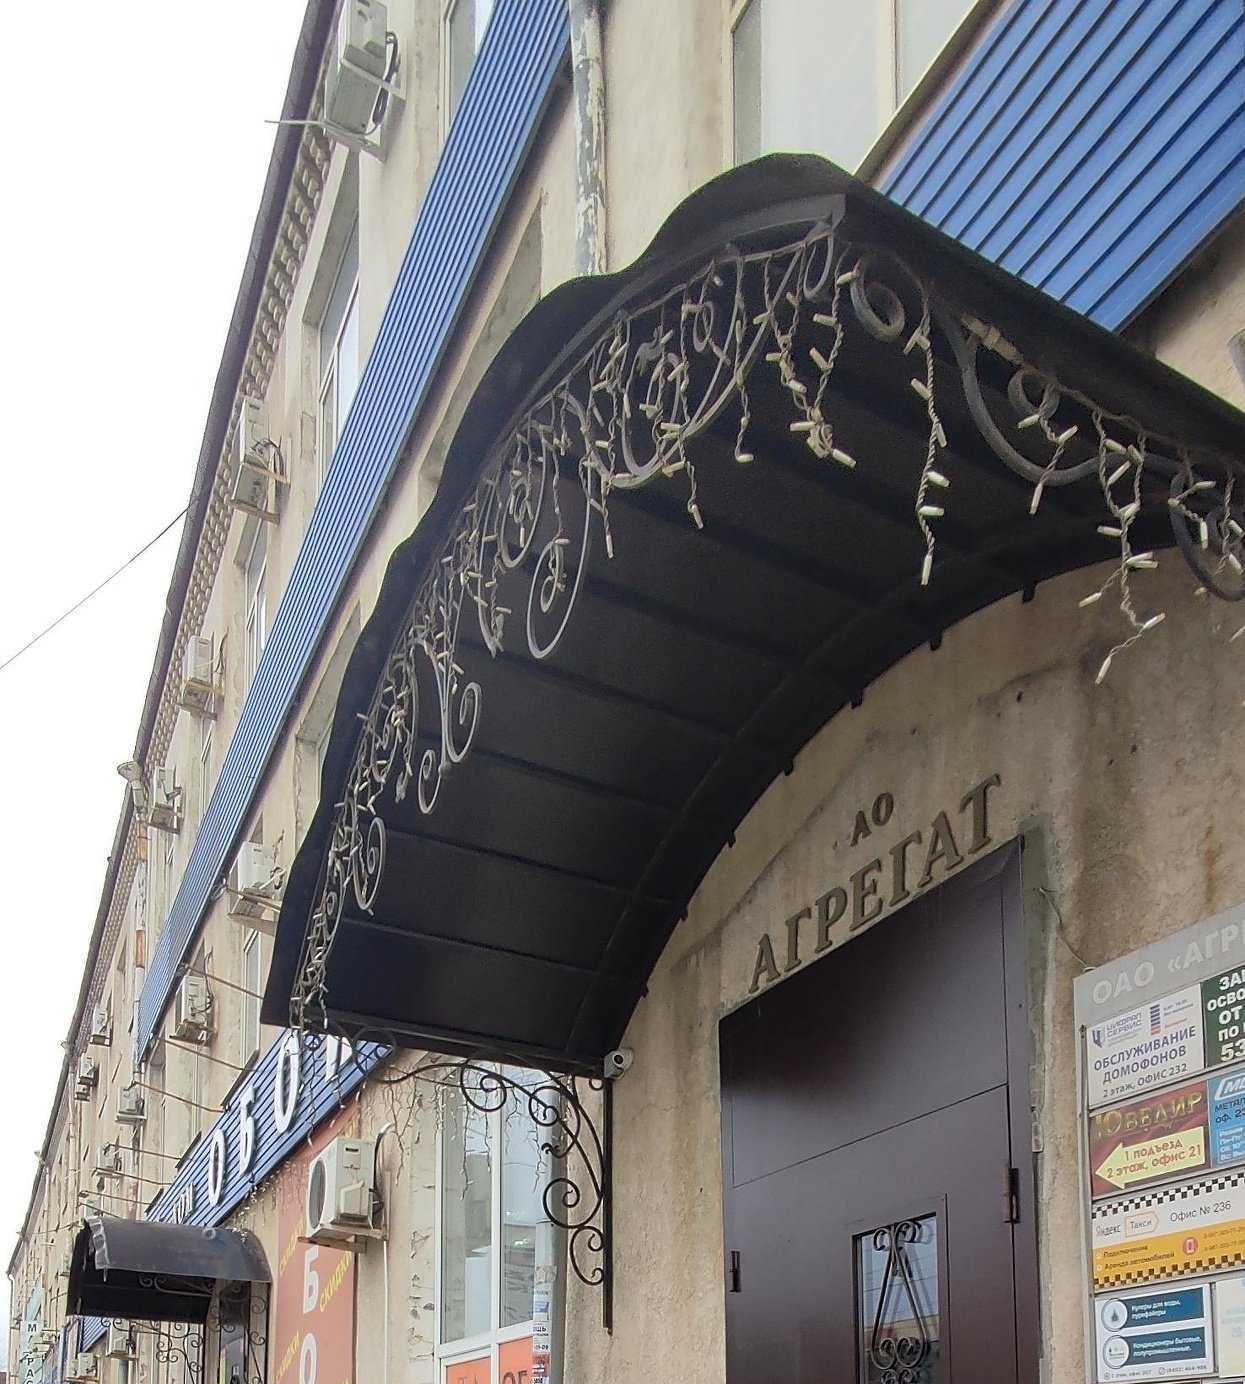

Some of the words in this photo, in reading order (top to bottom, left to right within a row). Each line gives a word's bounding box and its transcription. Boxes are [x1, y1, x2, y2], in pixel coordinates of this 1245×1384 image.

[850, 791, 895, 847] АО
[748, 773, 1001, 993] АГРЕГАТ
[1092, 961, 1154, 1005] ОАО
[1167, 919, 1245, 972] «АГР
[1219, 969, 1245, 991] ЗА
[1218, 1025, 1240, 1042] ПО
[1219, 1005, 1243, 1025] ОТ
[1094, 1025, 1196, 1071] ОБСЛУЖИВАНИЕ
[1102, 1046, 1186, 1085] ДОМОФОНОВ
[1137, 1069, 1167, 1086] ОФИС
[1169, 1063, 1188, 1079] 232
[1106, 1168, 1114, 1179] 2
[1151, 1149, 1186, 1168] офис
[1133, 1139, 1183, 1159] подъезд
[1095, 1223, 1121, 1237] Яндекс
[1129, 1218, 1153, 1231] Такси
[1170, 1208, 1197, 1223] Офис
[1213, 1200, 1232, 1213] 236
[319, 1250, 353, 1313] СКИДКИ
